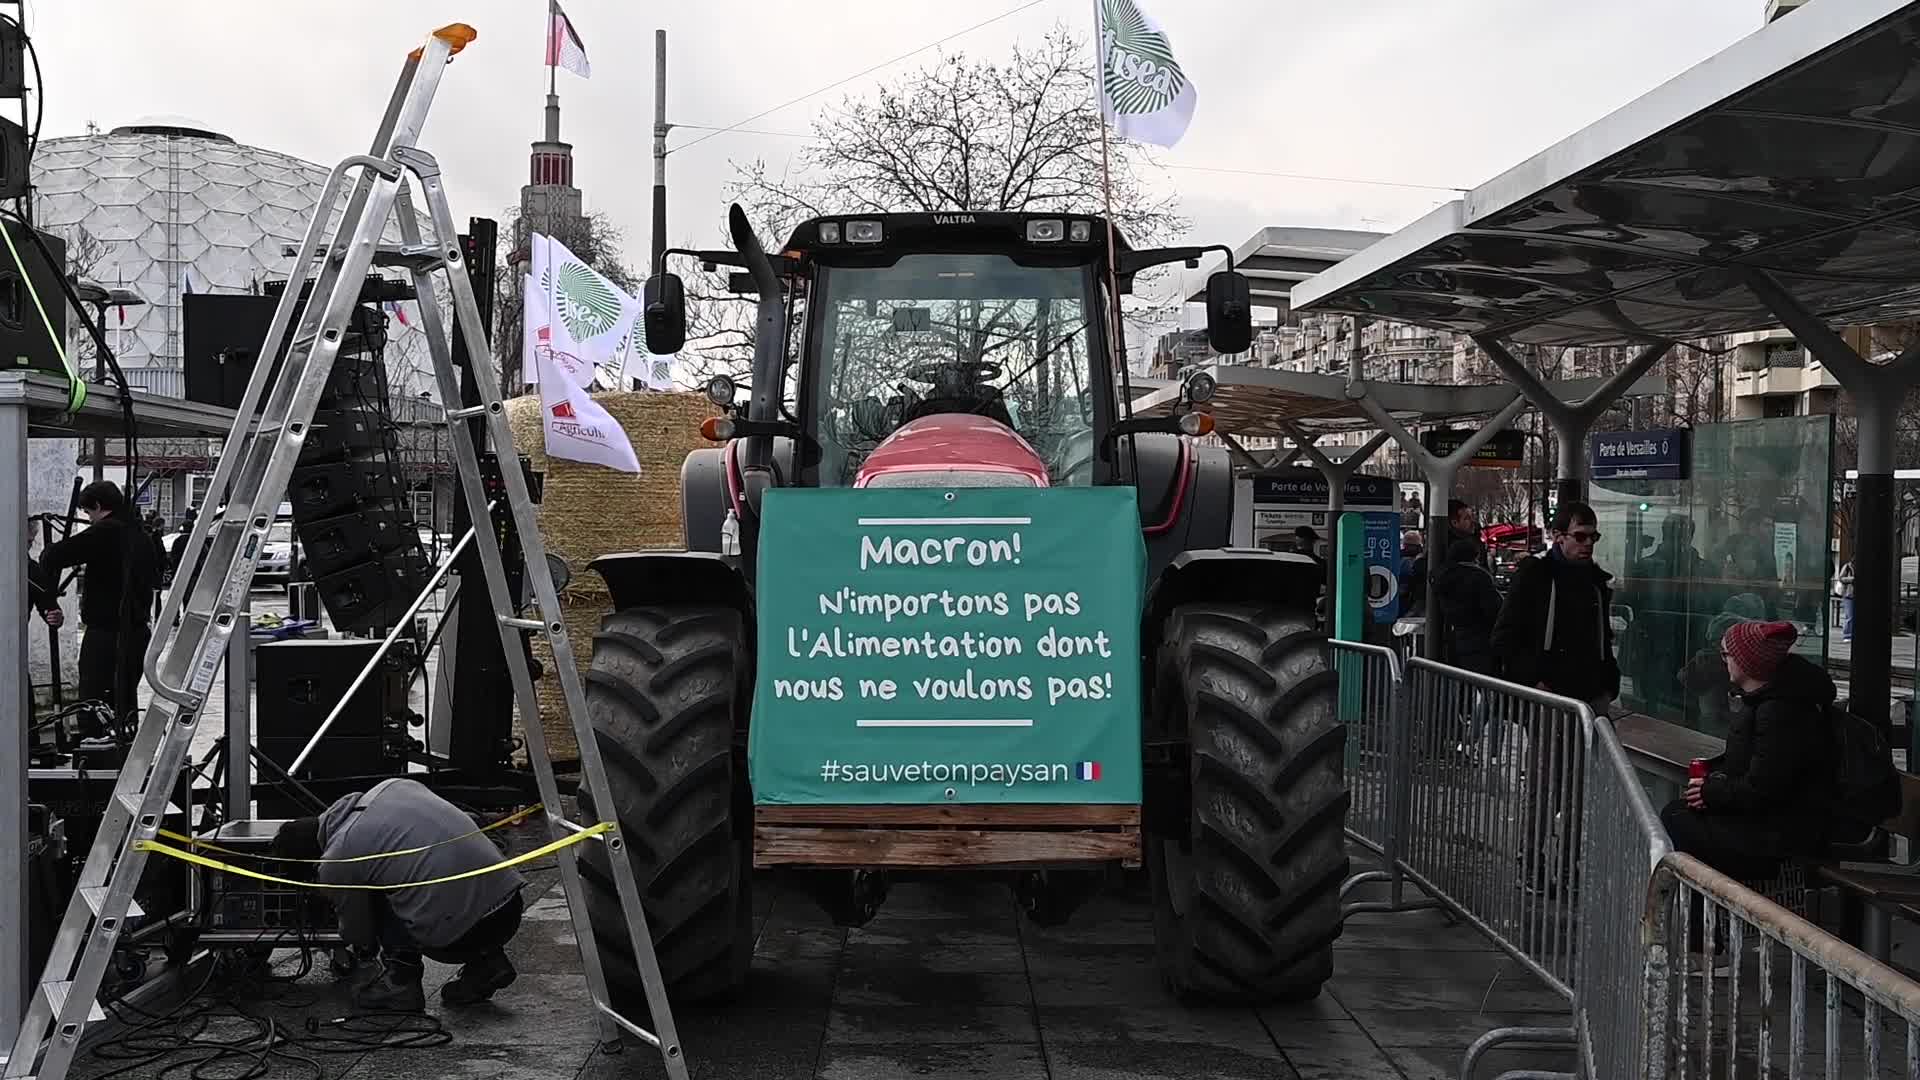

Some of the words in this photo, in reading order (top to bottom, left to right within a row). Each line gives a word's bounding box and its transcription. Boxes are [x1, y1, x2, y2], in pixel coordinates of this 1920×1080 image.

[933, 215, 975, 224] VALTRA
[1599, 442, 1616, 456] Porte
[1617, 441, 1625, 456] de
[1626, 440, 1657, 456] Versailles
[1271, 482, 1298, 492] Porte
[1300, 482, 1312, 492] de
[859, 532, 1022, 570] Macron!
[819, 587, 1009, 622] N'importons
[1025, 590, 1081, 621] pas
[788, 627, 1022, 658] l'Alimentation
[1037, 627, 1112, 658] dont
[774, 677, 844, 701] nous
[860, 677, 897, 700] ne
[913, 669, 1033, 700] voulons
[1048, 672, 1112, 706] pas!
[820, 760, 1069, 787] #sauvetonpaysan
